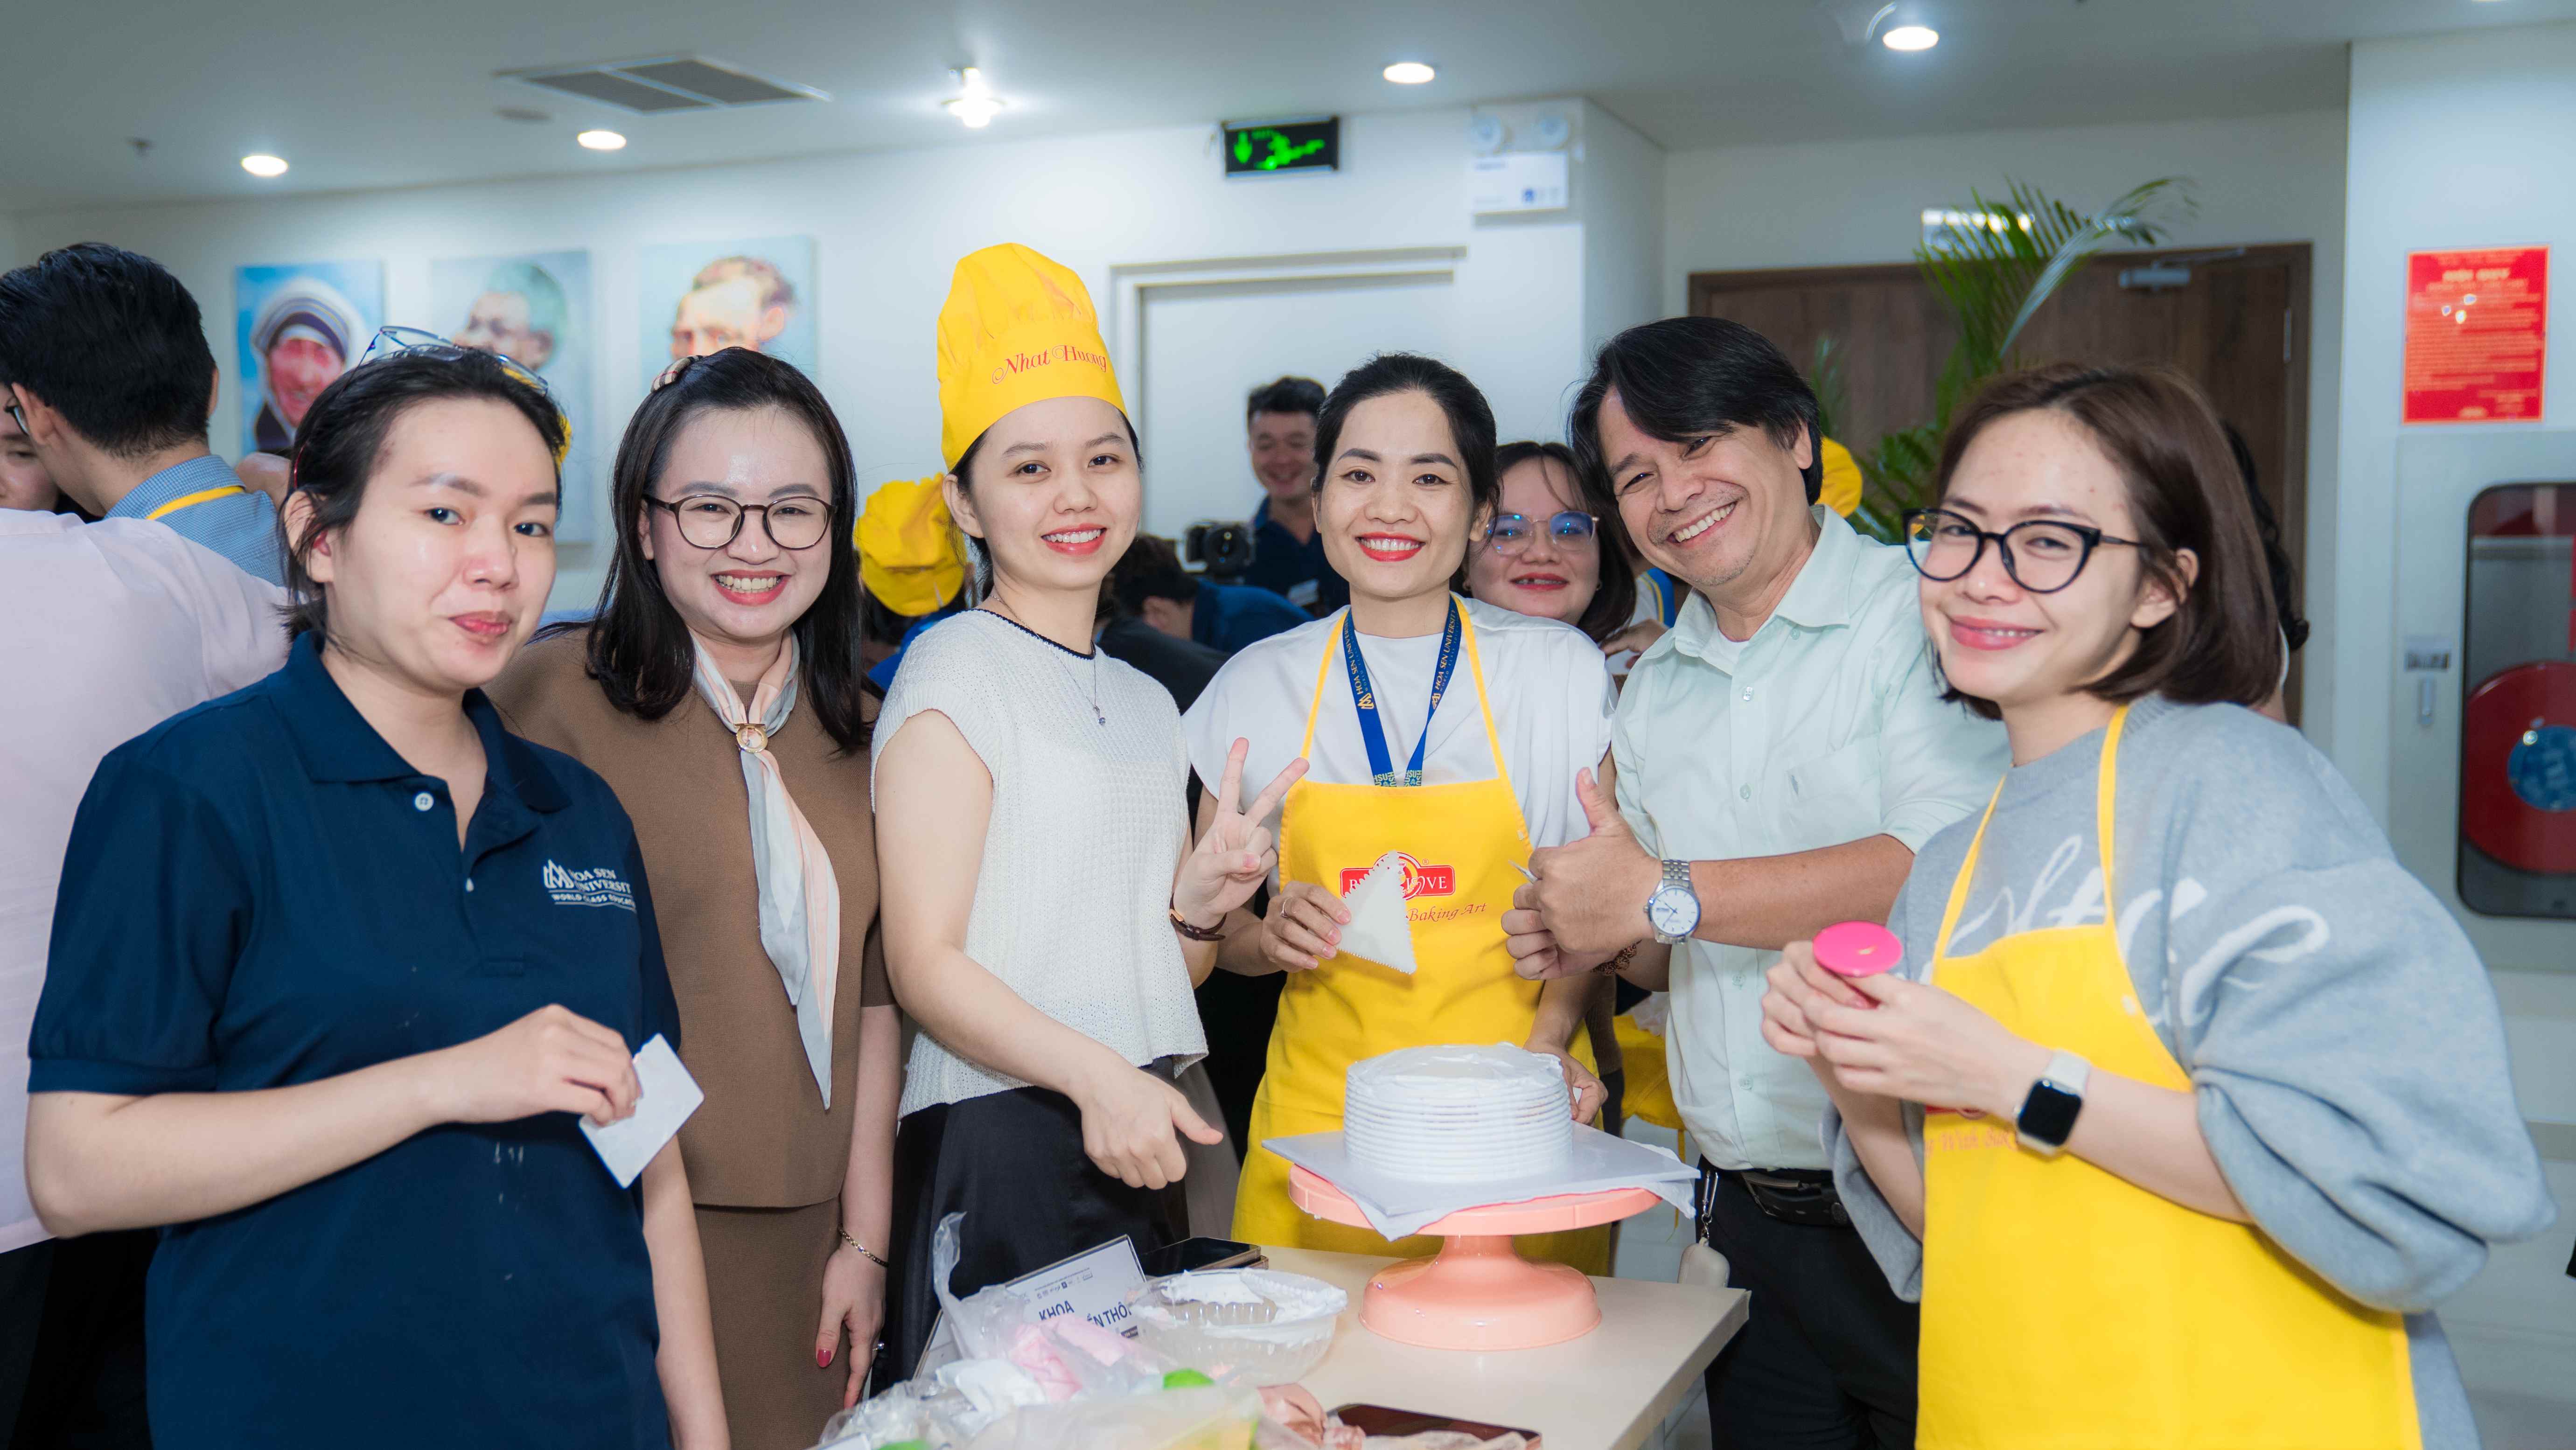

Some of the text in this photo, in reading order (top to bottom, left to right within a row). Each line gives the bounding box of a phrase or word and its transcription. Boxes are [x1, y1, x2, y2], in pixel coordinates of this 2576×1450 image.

[992, 345, 1107, 384] Nhat Huong
[1435, 671, 1444, 690] HOA
[1440, 654, 1449, 669] SEN
[1354, 675, 1363, 695] HOA
[574, 879, 631, 894] UNIVERSIT
[1409, 903, 1487, 922] Baking Art
[1039, 1300, 1075, 1321] KHOA
